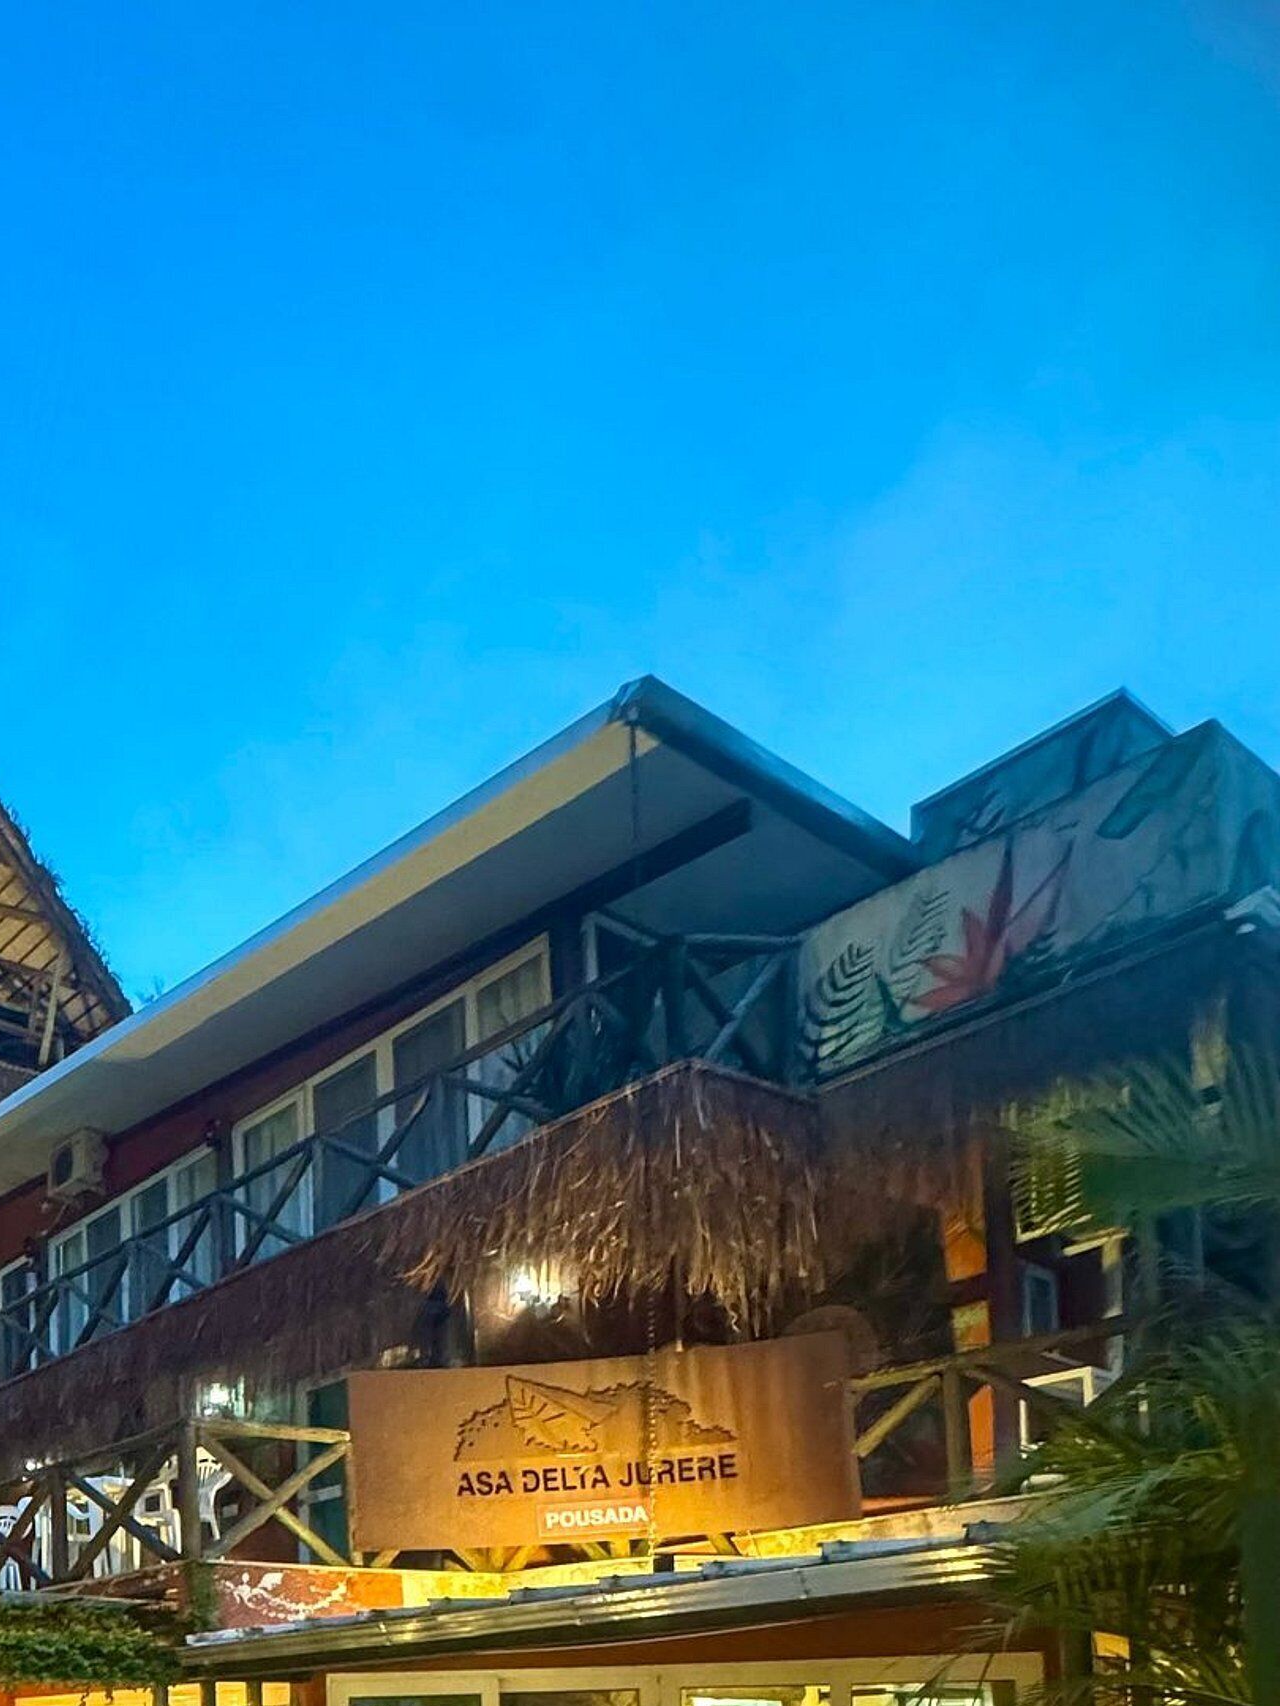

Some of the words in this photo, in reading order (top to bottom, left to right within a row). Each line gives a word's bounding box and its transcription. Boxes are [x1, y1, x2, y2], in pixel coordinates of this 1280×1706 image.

[457, 1470, 514, 1497] ASA
[522, 1464, 610, 1494] DELTA
[619, 1453, 739, 1488] JURERE
[545, 1504, 649, 1530] POUSADA
